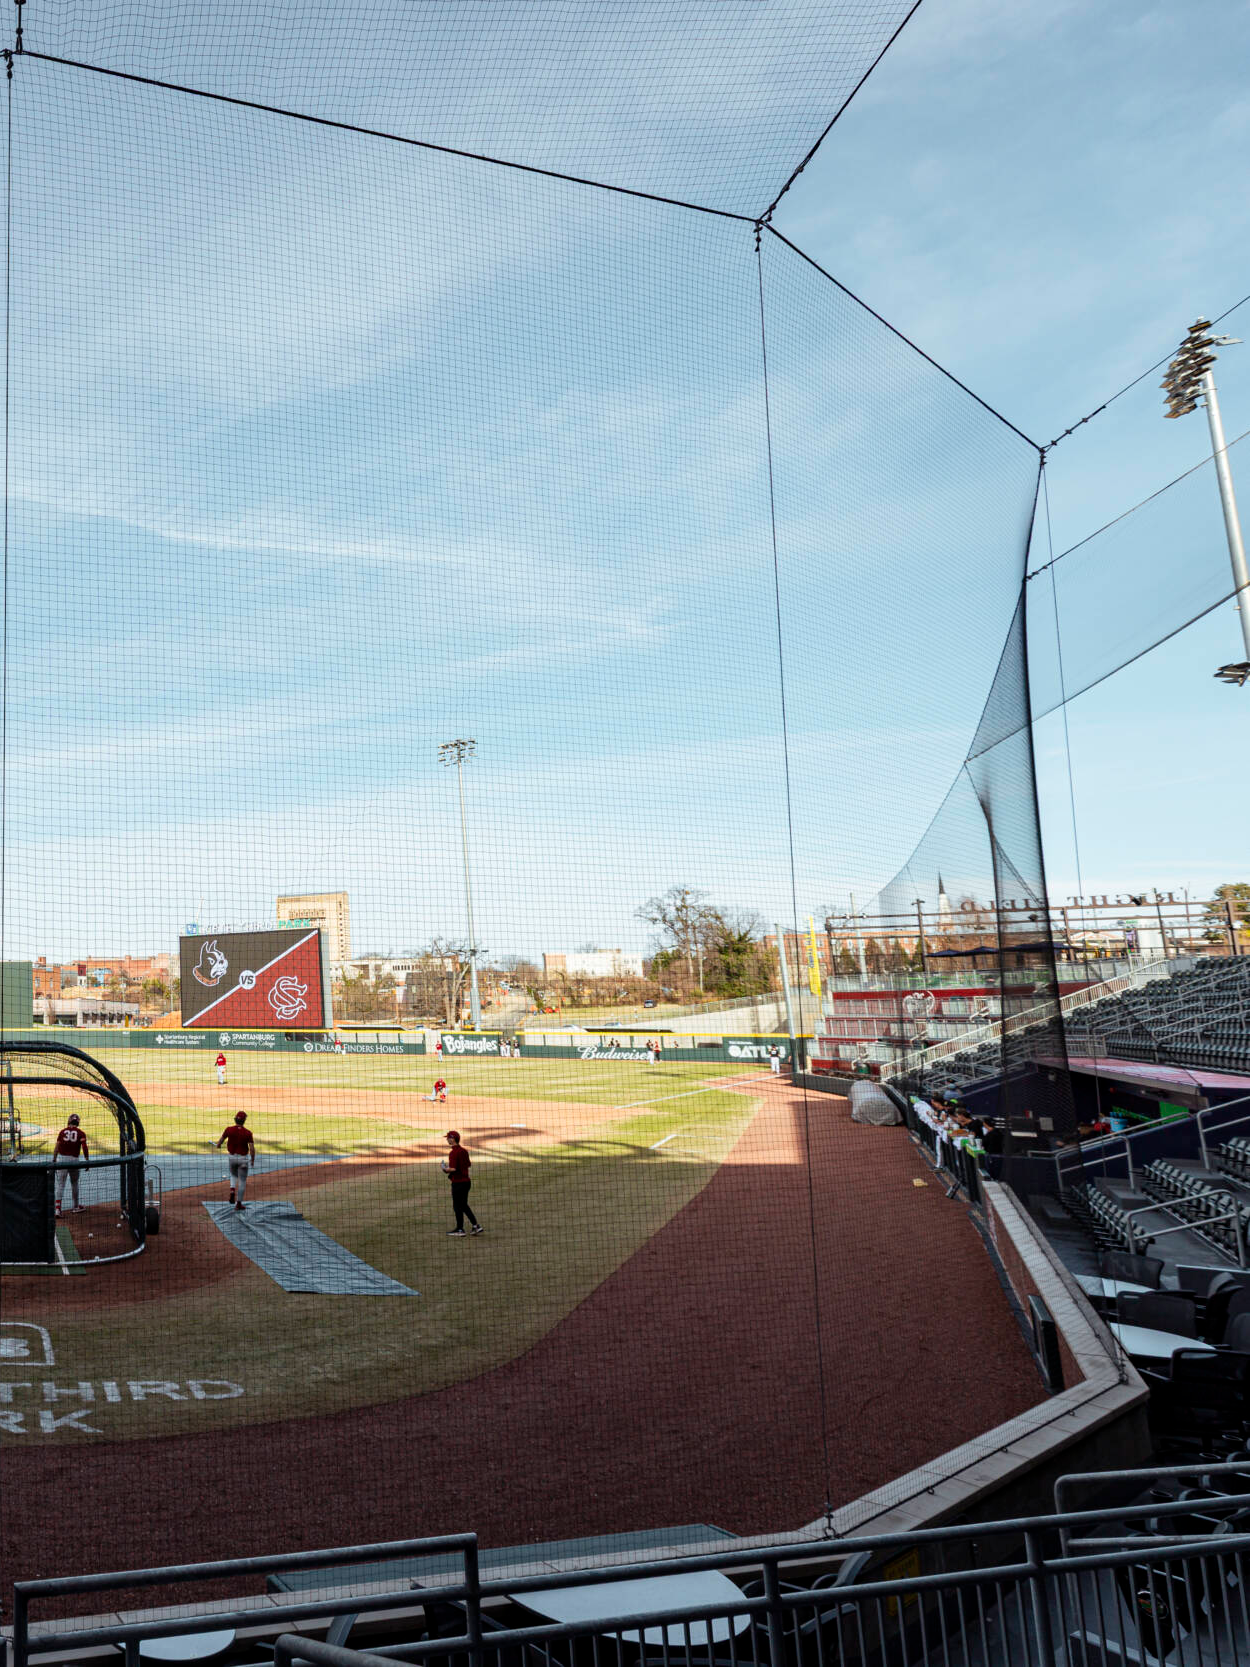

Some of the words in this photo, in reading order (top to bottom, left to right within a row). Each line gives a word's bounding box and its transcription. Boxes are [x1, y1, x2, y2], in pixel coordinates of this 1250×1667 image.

[278, 918, 311, 929] PARK
[240, 975, 254, 984] VS
[232, 1033, 275, 1041] SPARTANBURG
[232, 1040, 257, 1048] Community
[315, 1043, 343, 1052] DREA
[343, 1043, 374, 1053] FINDERS
[376, 1045, 404, 1054] HOMES
[442, 1034, 497, 1054] Bojangles
[578, 1046, 651, 1060] Budweise
[63, 1130, 78, 1142] 30
